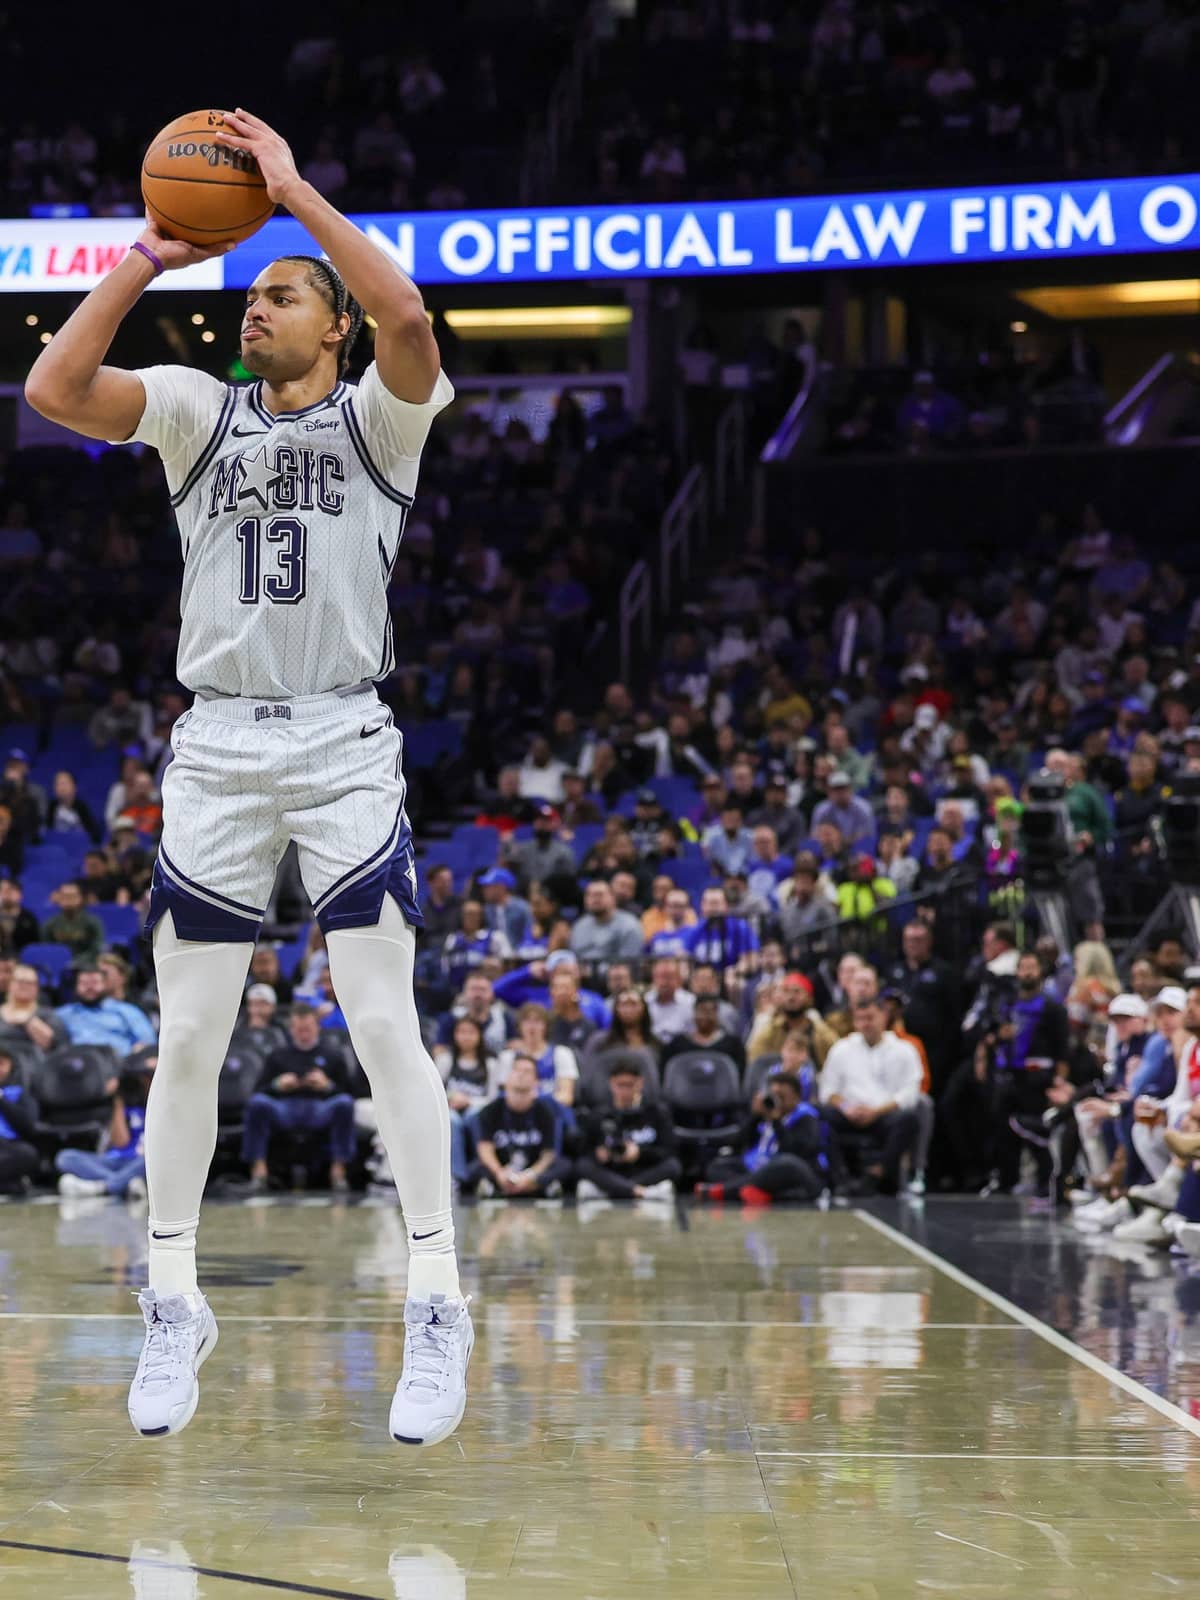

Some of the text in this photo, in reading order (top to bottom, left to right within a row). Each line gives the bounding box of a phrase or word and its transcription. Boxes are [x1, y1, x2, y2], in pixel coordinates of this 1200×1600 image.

[438, 211, 753, 276] OFFICIAL
[775, 200, 927, 264] LAW
[950, 191, 1115, 255] FIRM
[237, 517, 307, 604] 13
